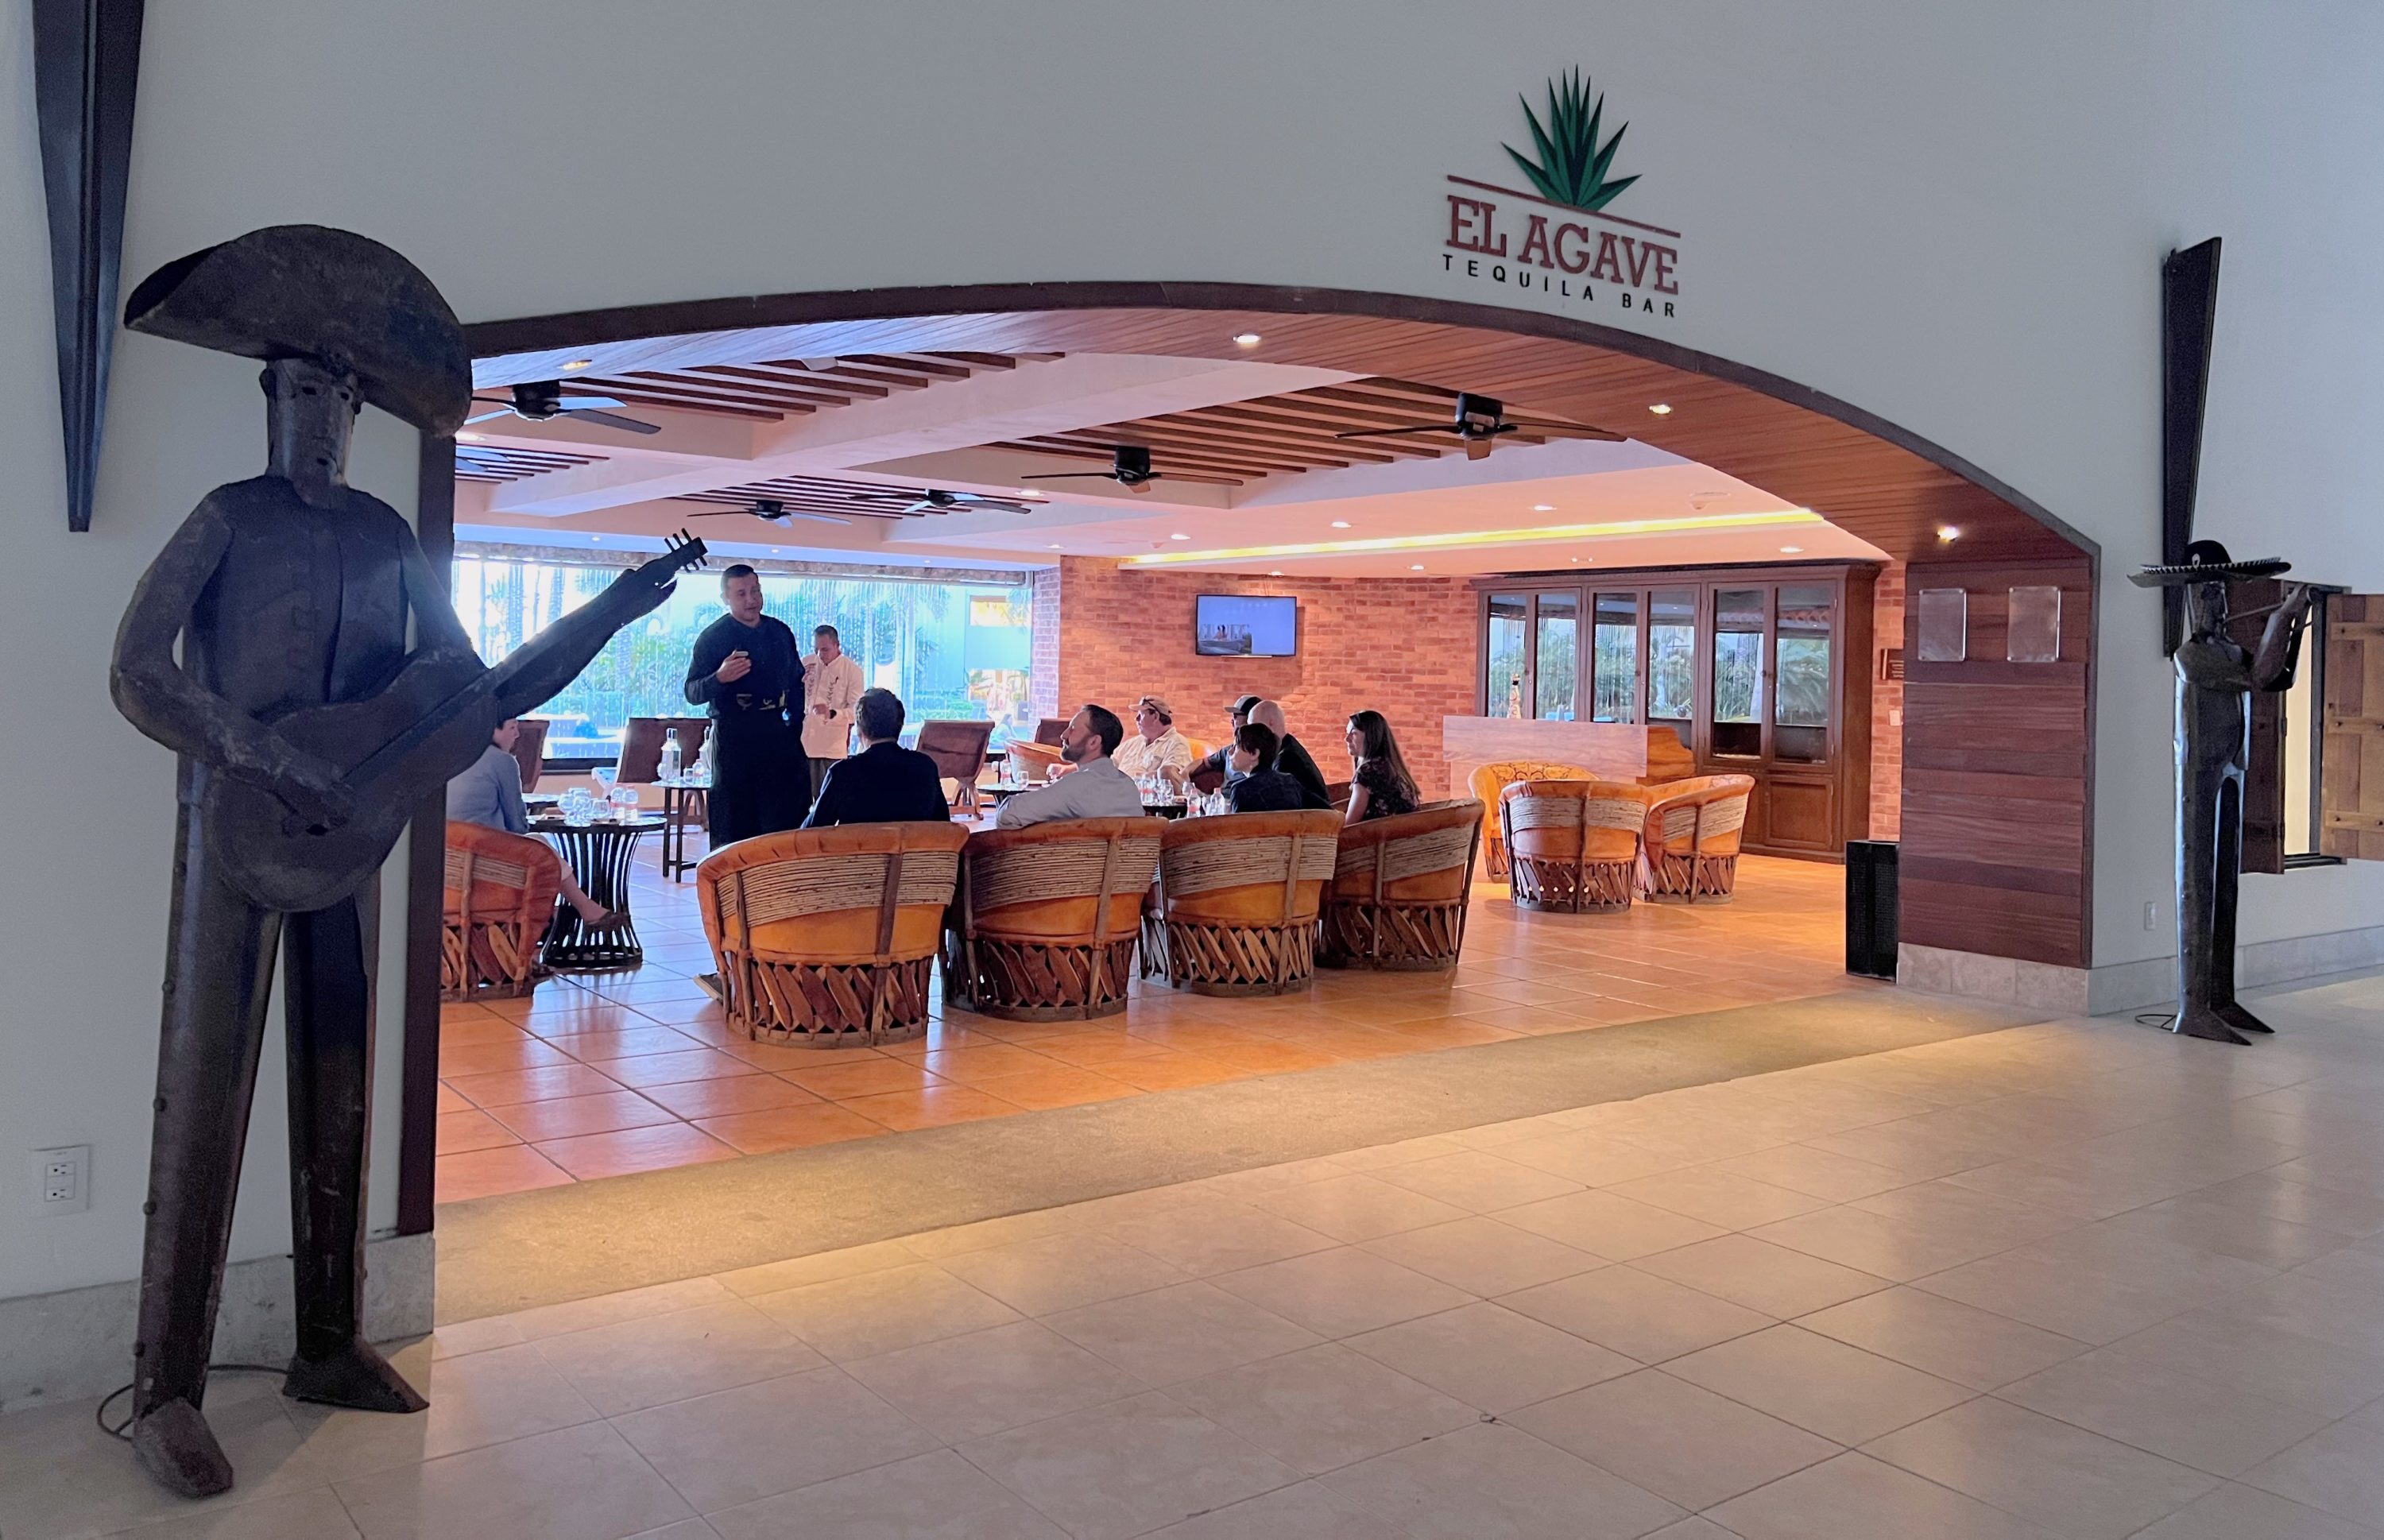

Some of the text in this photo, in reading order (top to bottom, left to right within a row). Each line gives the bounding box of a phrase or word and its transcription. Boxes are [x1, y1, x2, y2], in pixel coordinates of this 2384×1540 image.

[1442, 254, 1674, 318] TEQUILA BAR
[1446, 195, 1678, 295] EL AGAVE
